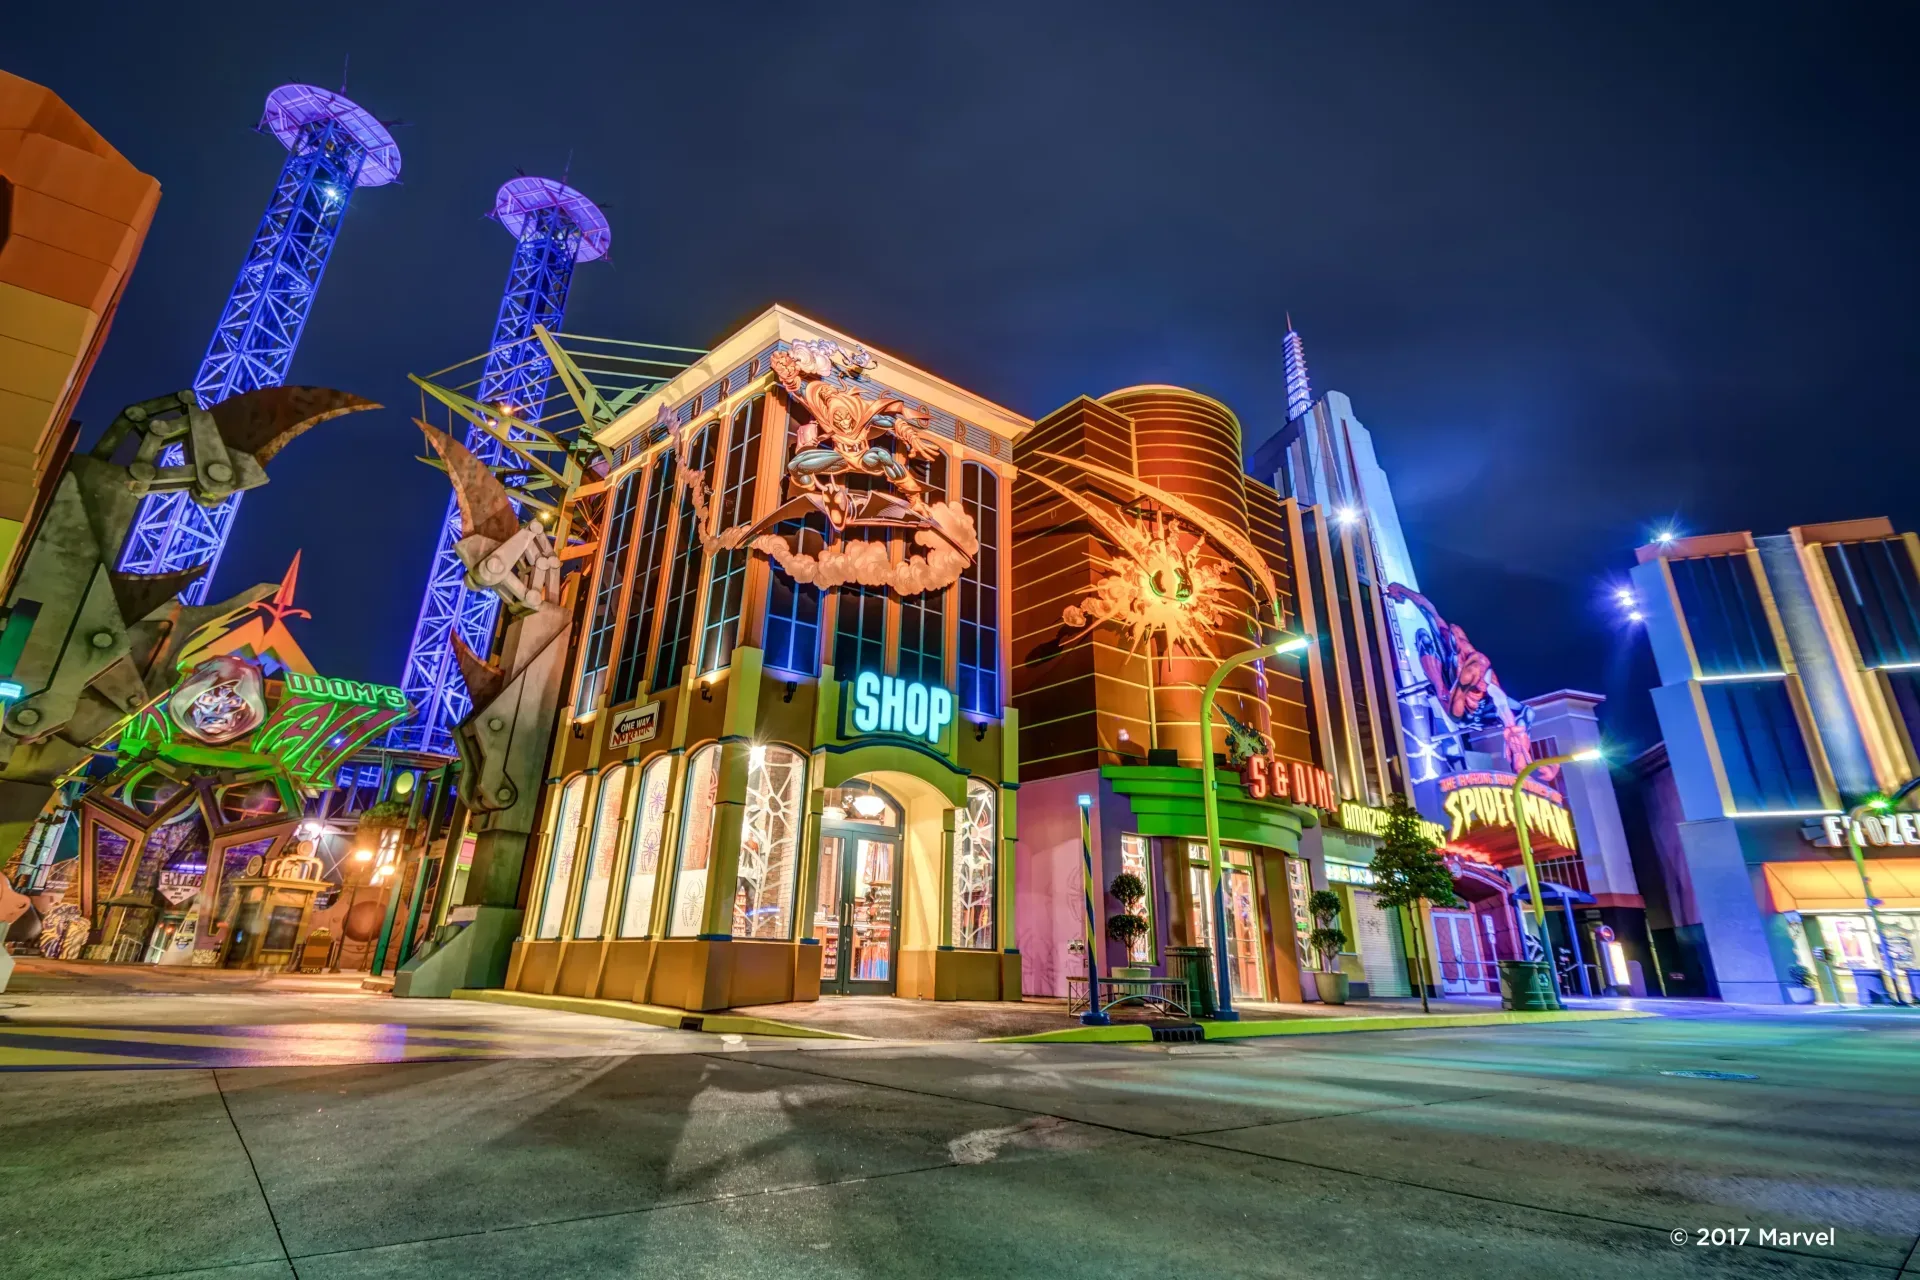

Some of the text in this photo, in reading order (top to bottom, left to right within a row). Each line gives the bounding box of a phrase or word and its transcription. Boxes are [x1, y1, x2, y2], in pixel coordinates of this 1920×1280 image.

[284, 671, 407, 708] DOOM'S
[855, 671, 952, 744] SHOP
[252, 696, 408, 787] FALL
[620, 716, 651, 733] ONE WAY
[1271, 761, 1290, 798] &
[1291, 762, 1339, 812] DIME
[1823, 813, 1920, 848] FROZE
[161, 871, 203, 888] ENTER
